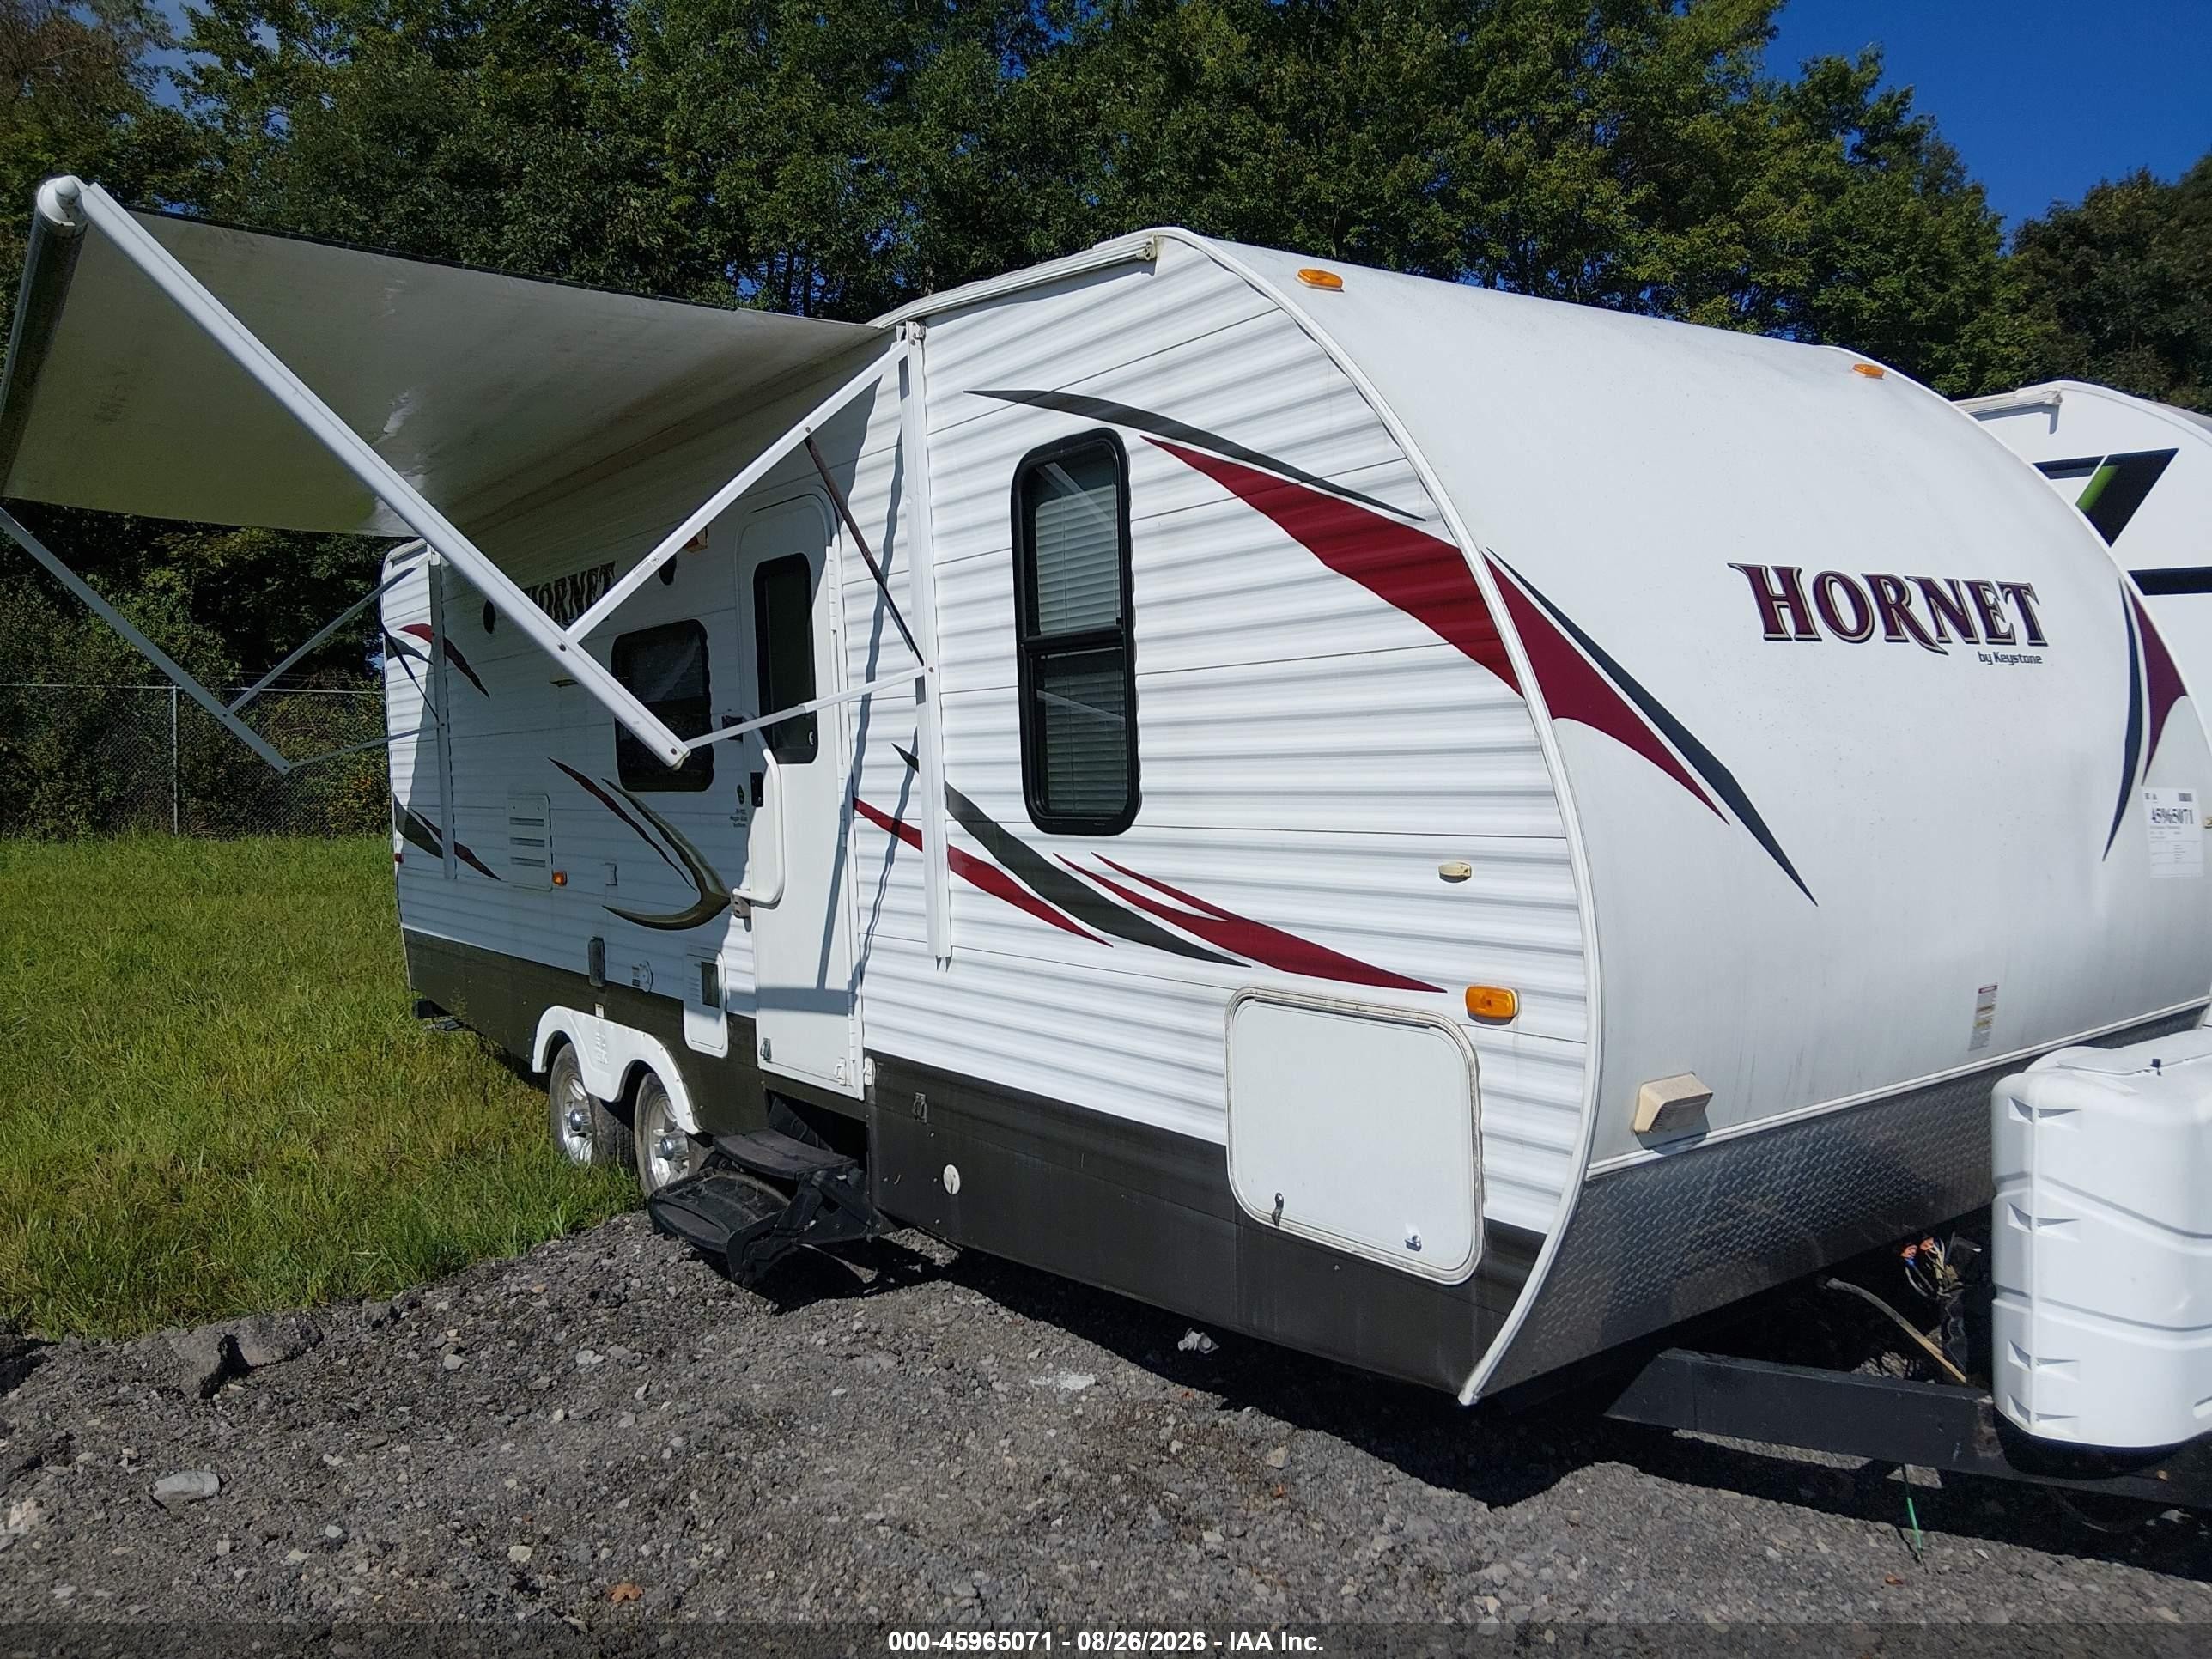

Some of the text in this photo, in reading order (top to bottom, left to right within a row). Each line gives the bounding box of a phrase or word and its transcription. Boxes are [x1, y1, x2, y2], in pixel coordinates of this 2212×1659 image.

[1727, 562, 2048, 655] HORNET
[1978, 651, 2043, 665] by Keystone
